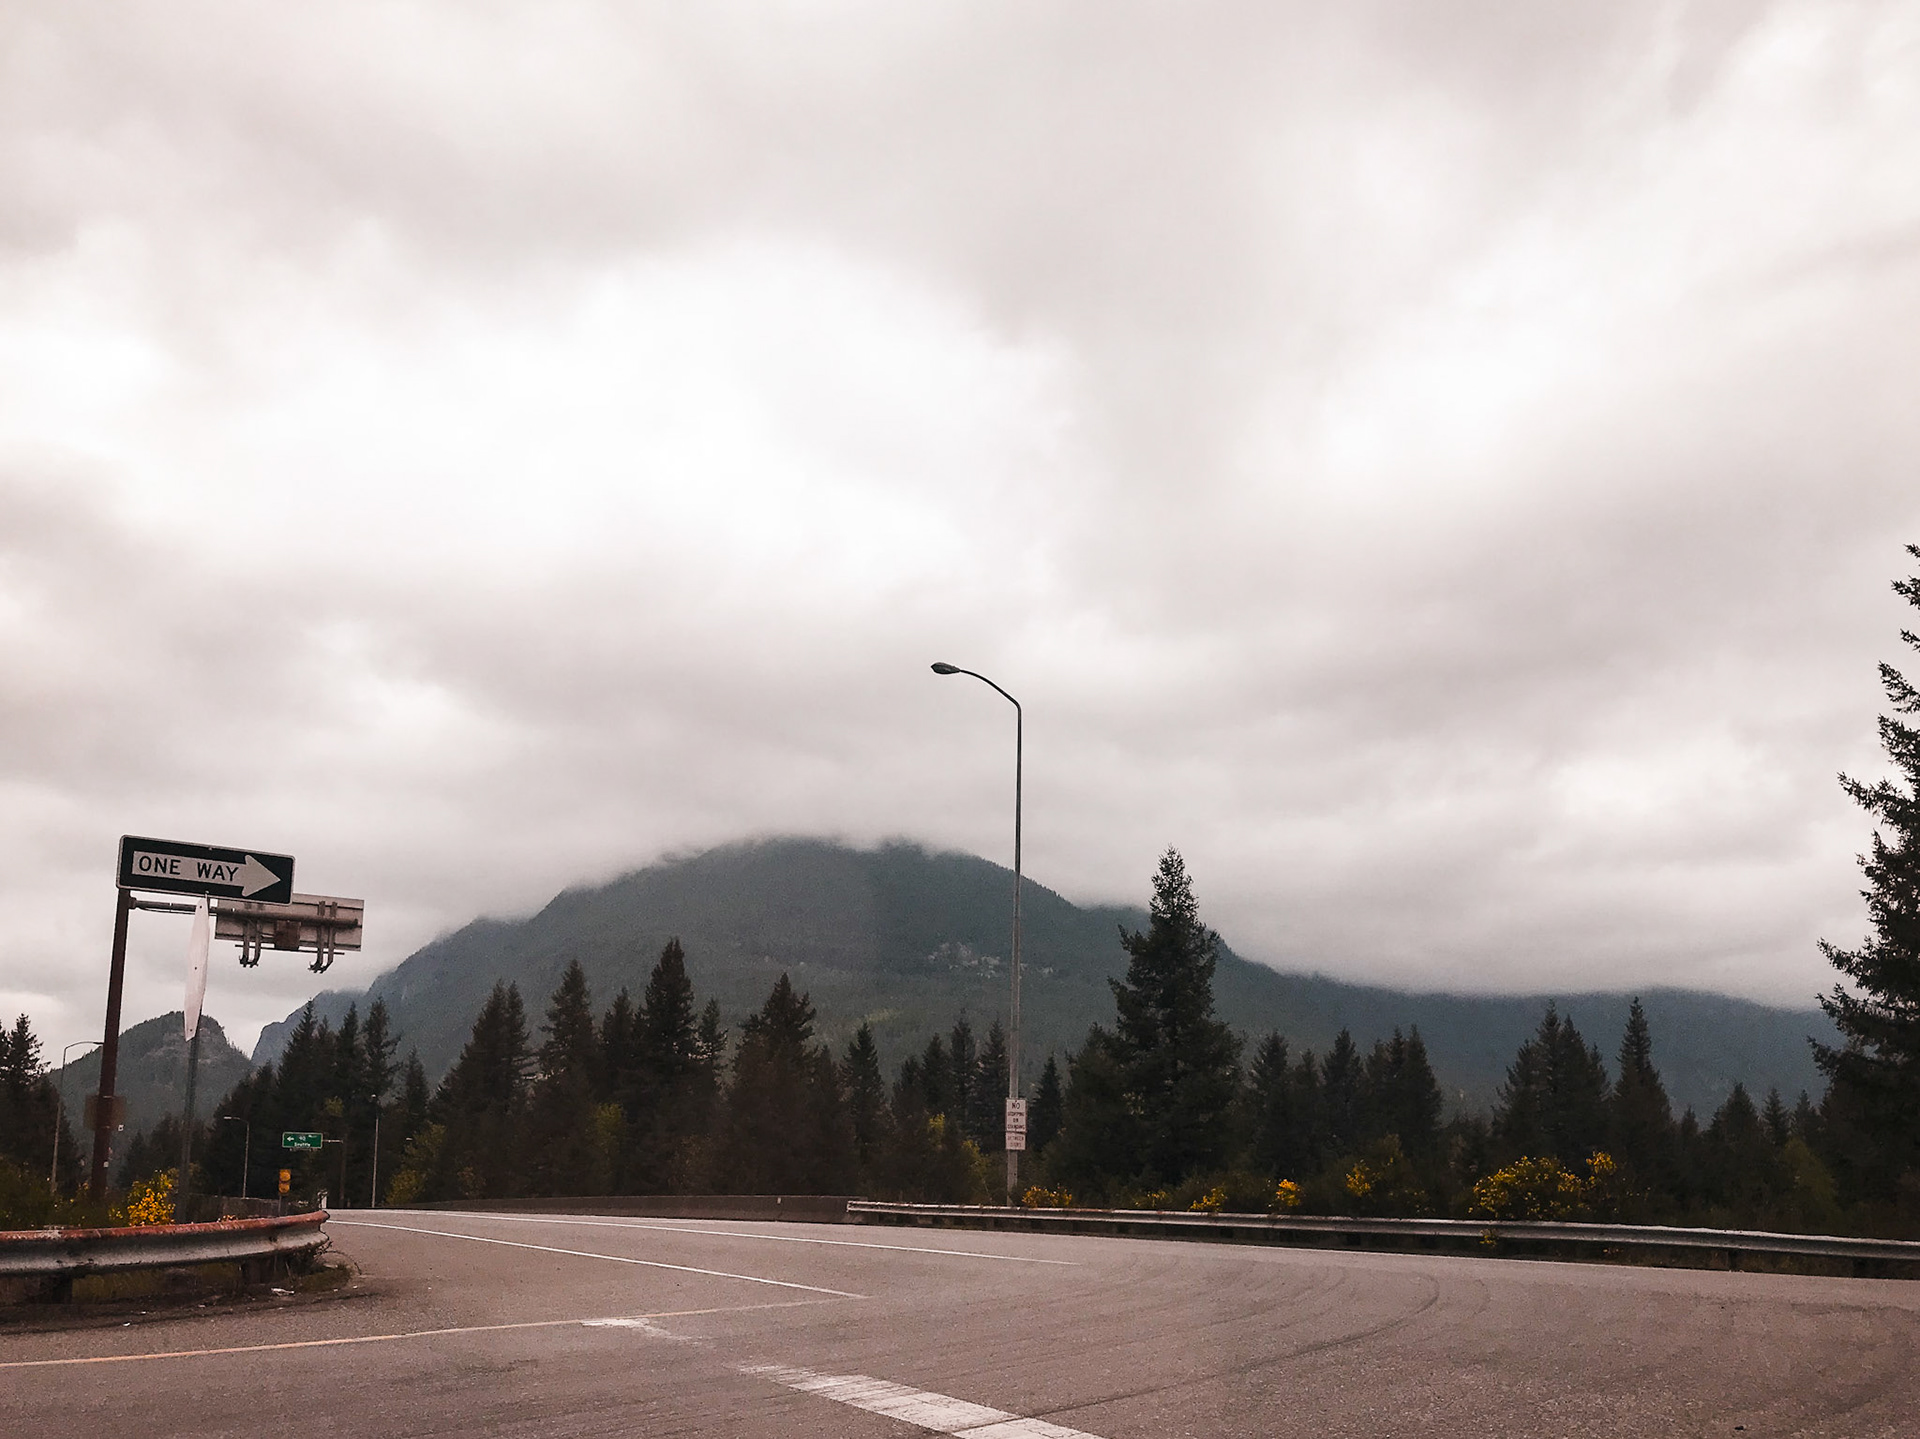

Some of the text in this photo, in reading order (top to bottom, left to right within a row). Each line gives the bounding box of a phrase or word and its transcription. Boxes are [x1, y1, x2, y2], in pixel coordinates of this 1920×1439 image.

[138, 855, 239, 881] ONE WAY
[1011, 1102, 1020, 1110] NO
